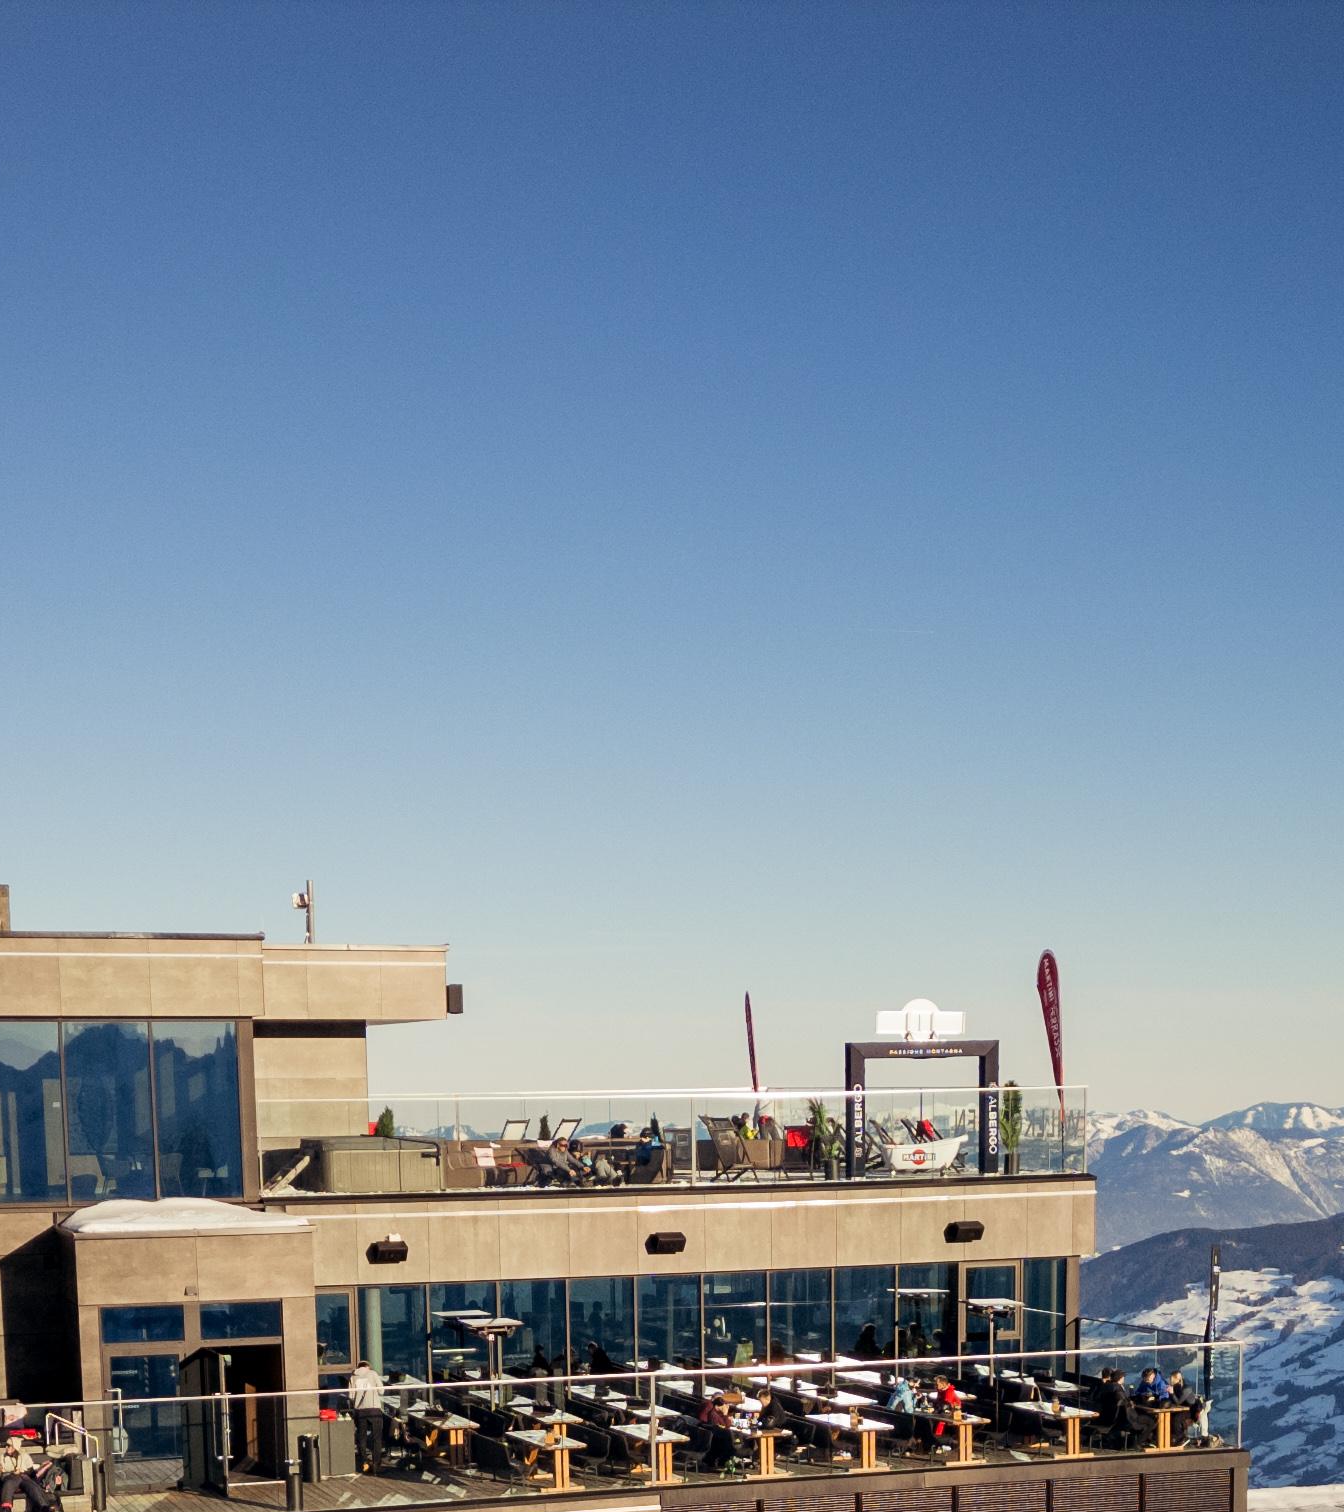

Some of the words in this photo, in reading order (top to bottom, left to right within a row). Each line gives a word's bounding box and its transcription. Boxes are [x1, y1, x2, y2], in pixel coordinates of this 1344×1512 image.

[854, 1083, 863, 1144] ALBERGO
[988, 1095, 998, 1154] ALBERGO
[903, 1153, 936, 1162] MARTINI
